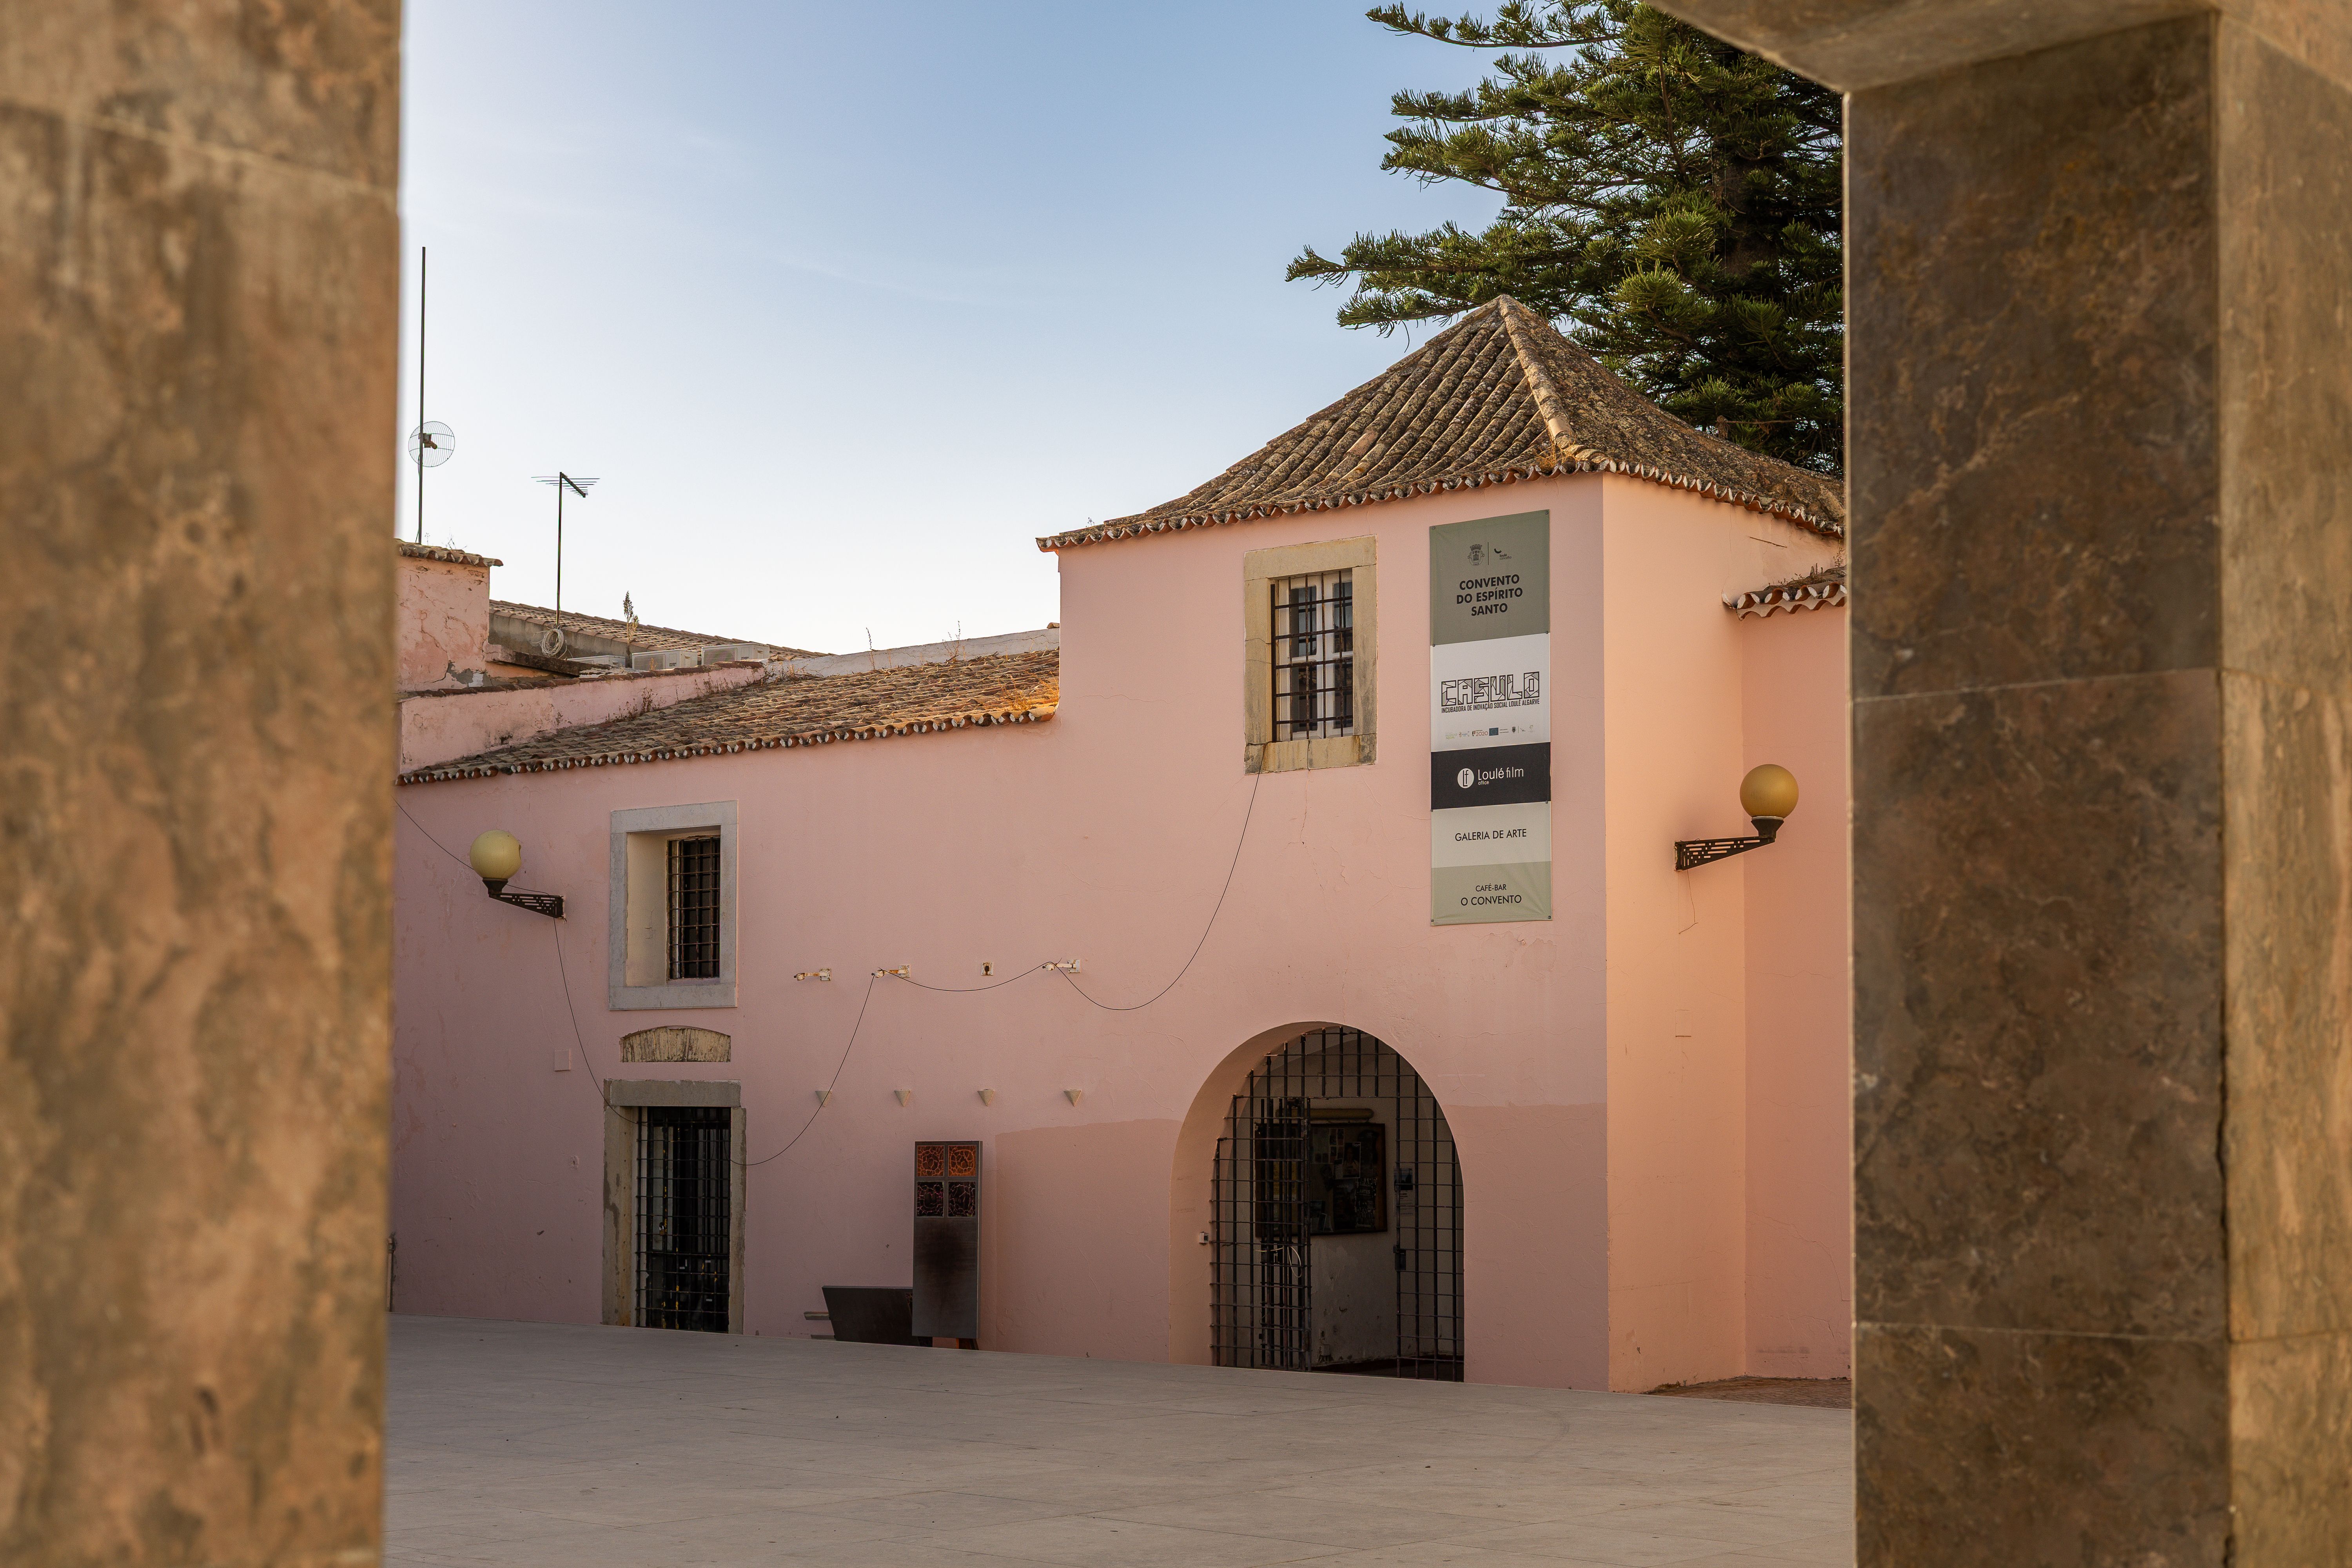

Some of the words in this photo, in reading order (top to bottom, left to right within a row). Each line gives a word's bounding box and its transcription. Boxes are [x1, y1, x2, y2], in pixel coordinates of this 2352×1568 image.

[1459, 574, 1519, 590] CONVENTO
[1456, 593, 1472, 604] DO
[1476, 587, 1523, 602] ESPÍRITO
[1471, 603, 1508, 616] SANTO
[1441, 671, 1539, 706] CASULO
[1473, 702, 1493, 710] INOVAÇÃO
[1478, 768, 1504, 780] Loulé
[1506, 767, 1524, 778] film
[1455, 831, 1490, 841] GALERIA
[1493, 830, 1504, 839] DE
[1506, 829, 1527, 838] ARTE
[1475, 883, 1506, 892] CAFÉ-BAR
[1461, 897, 1468, 906] O
[1471, 895, 1522, 906] CONVENTO
